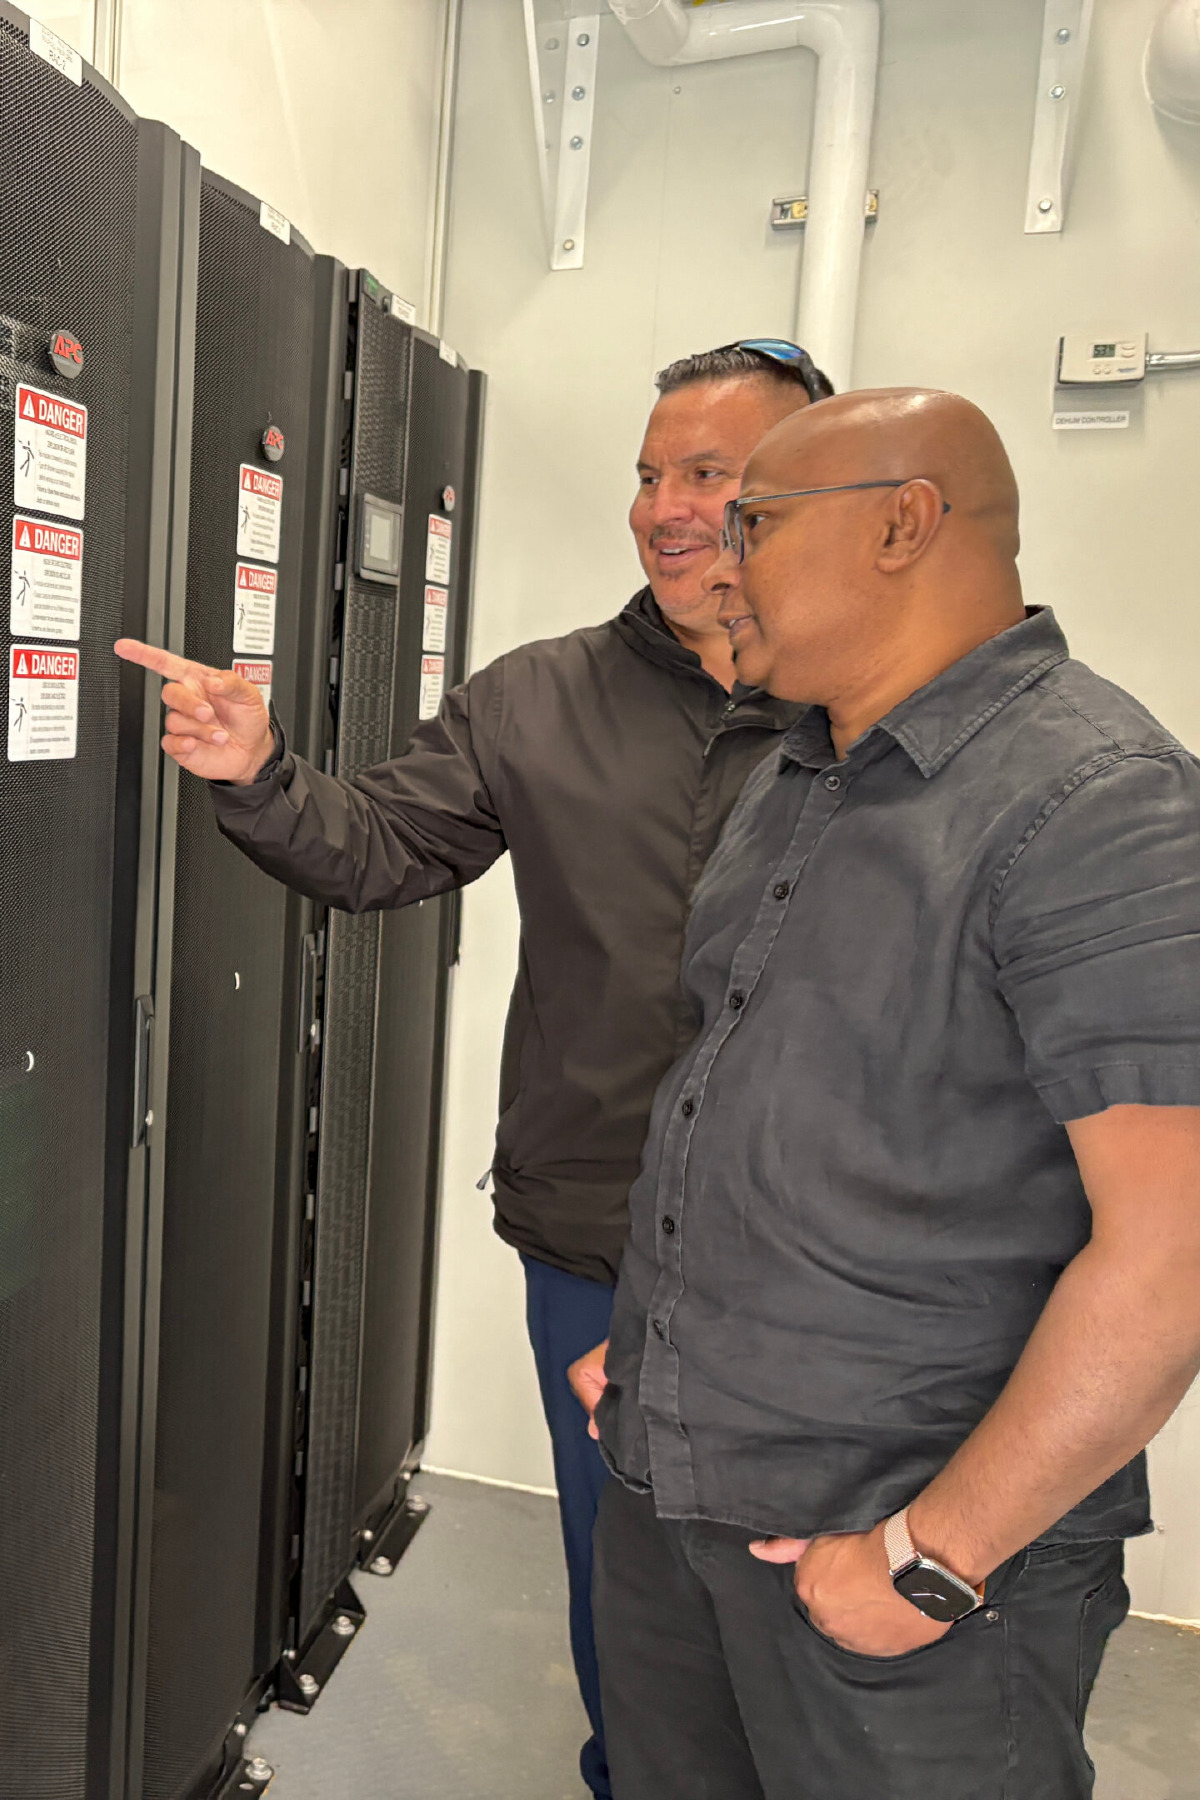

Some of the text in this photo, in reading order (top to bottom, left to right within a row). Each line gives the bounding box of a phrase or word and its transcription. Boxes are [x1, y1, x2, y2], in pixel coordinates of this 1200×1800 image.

[53, 334, 83, 364] APC
[38, 398, 84, 435] DANGER
[253, 474, 280, 497] DANGER
[34, 528, 79, 557] DANGER
[248, 571, 275, 591] DANGER
[31, 654, 75, 676] DANGER
[244, 666, 271, 684] DANGER
